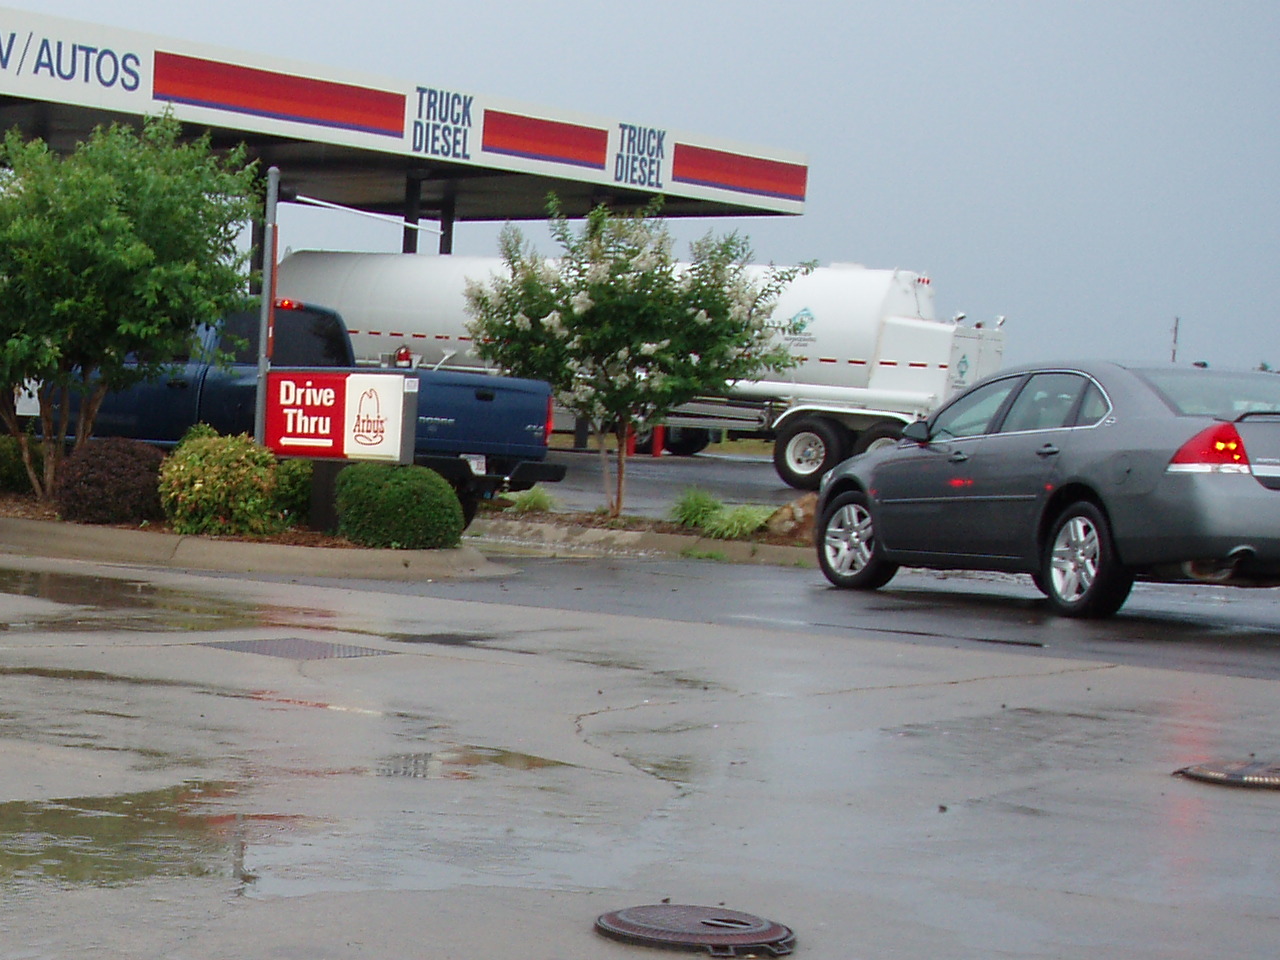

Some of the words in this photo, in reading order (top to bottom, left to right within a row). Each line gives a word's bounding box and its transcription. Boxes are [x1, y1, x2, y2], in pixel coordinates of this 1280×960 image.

[416, 84, 474, 128] TRUCK
[412, 120, 471, 160] DIESEL
[618, 122, 666, 160] TRUCK
[613, 153, 663, 189] DIESEL
[279, 379, 335, 406] Drive
[282, 407, 331, 434] Thru
[353, 414, 384, 436] Arby's
